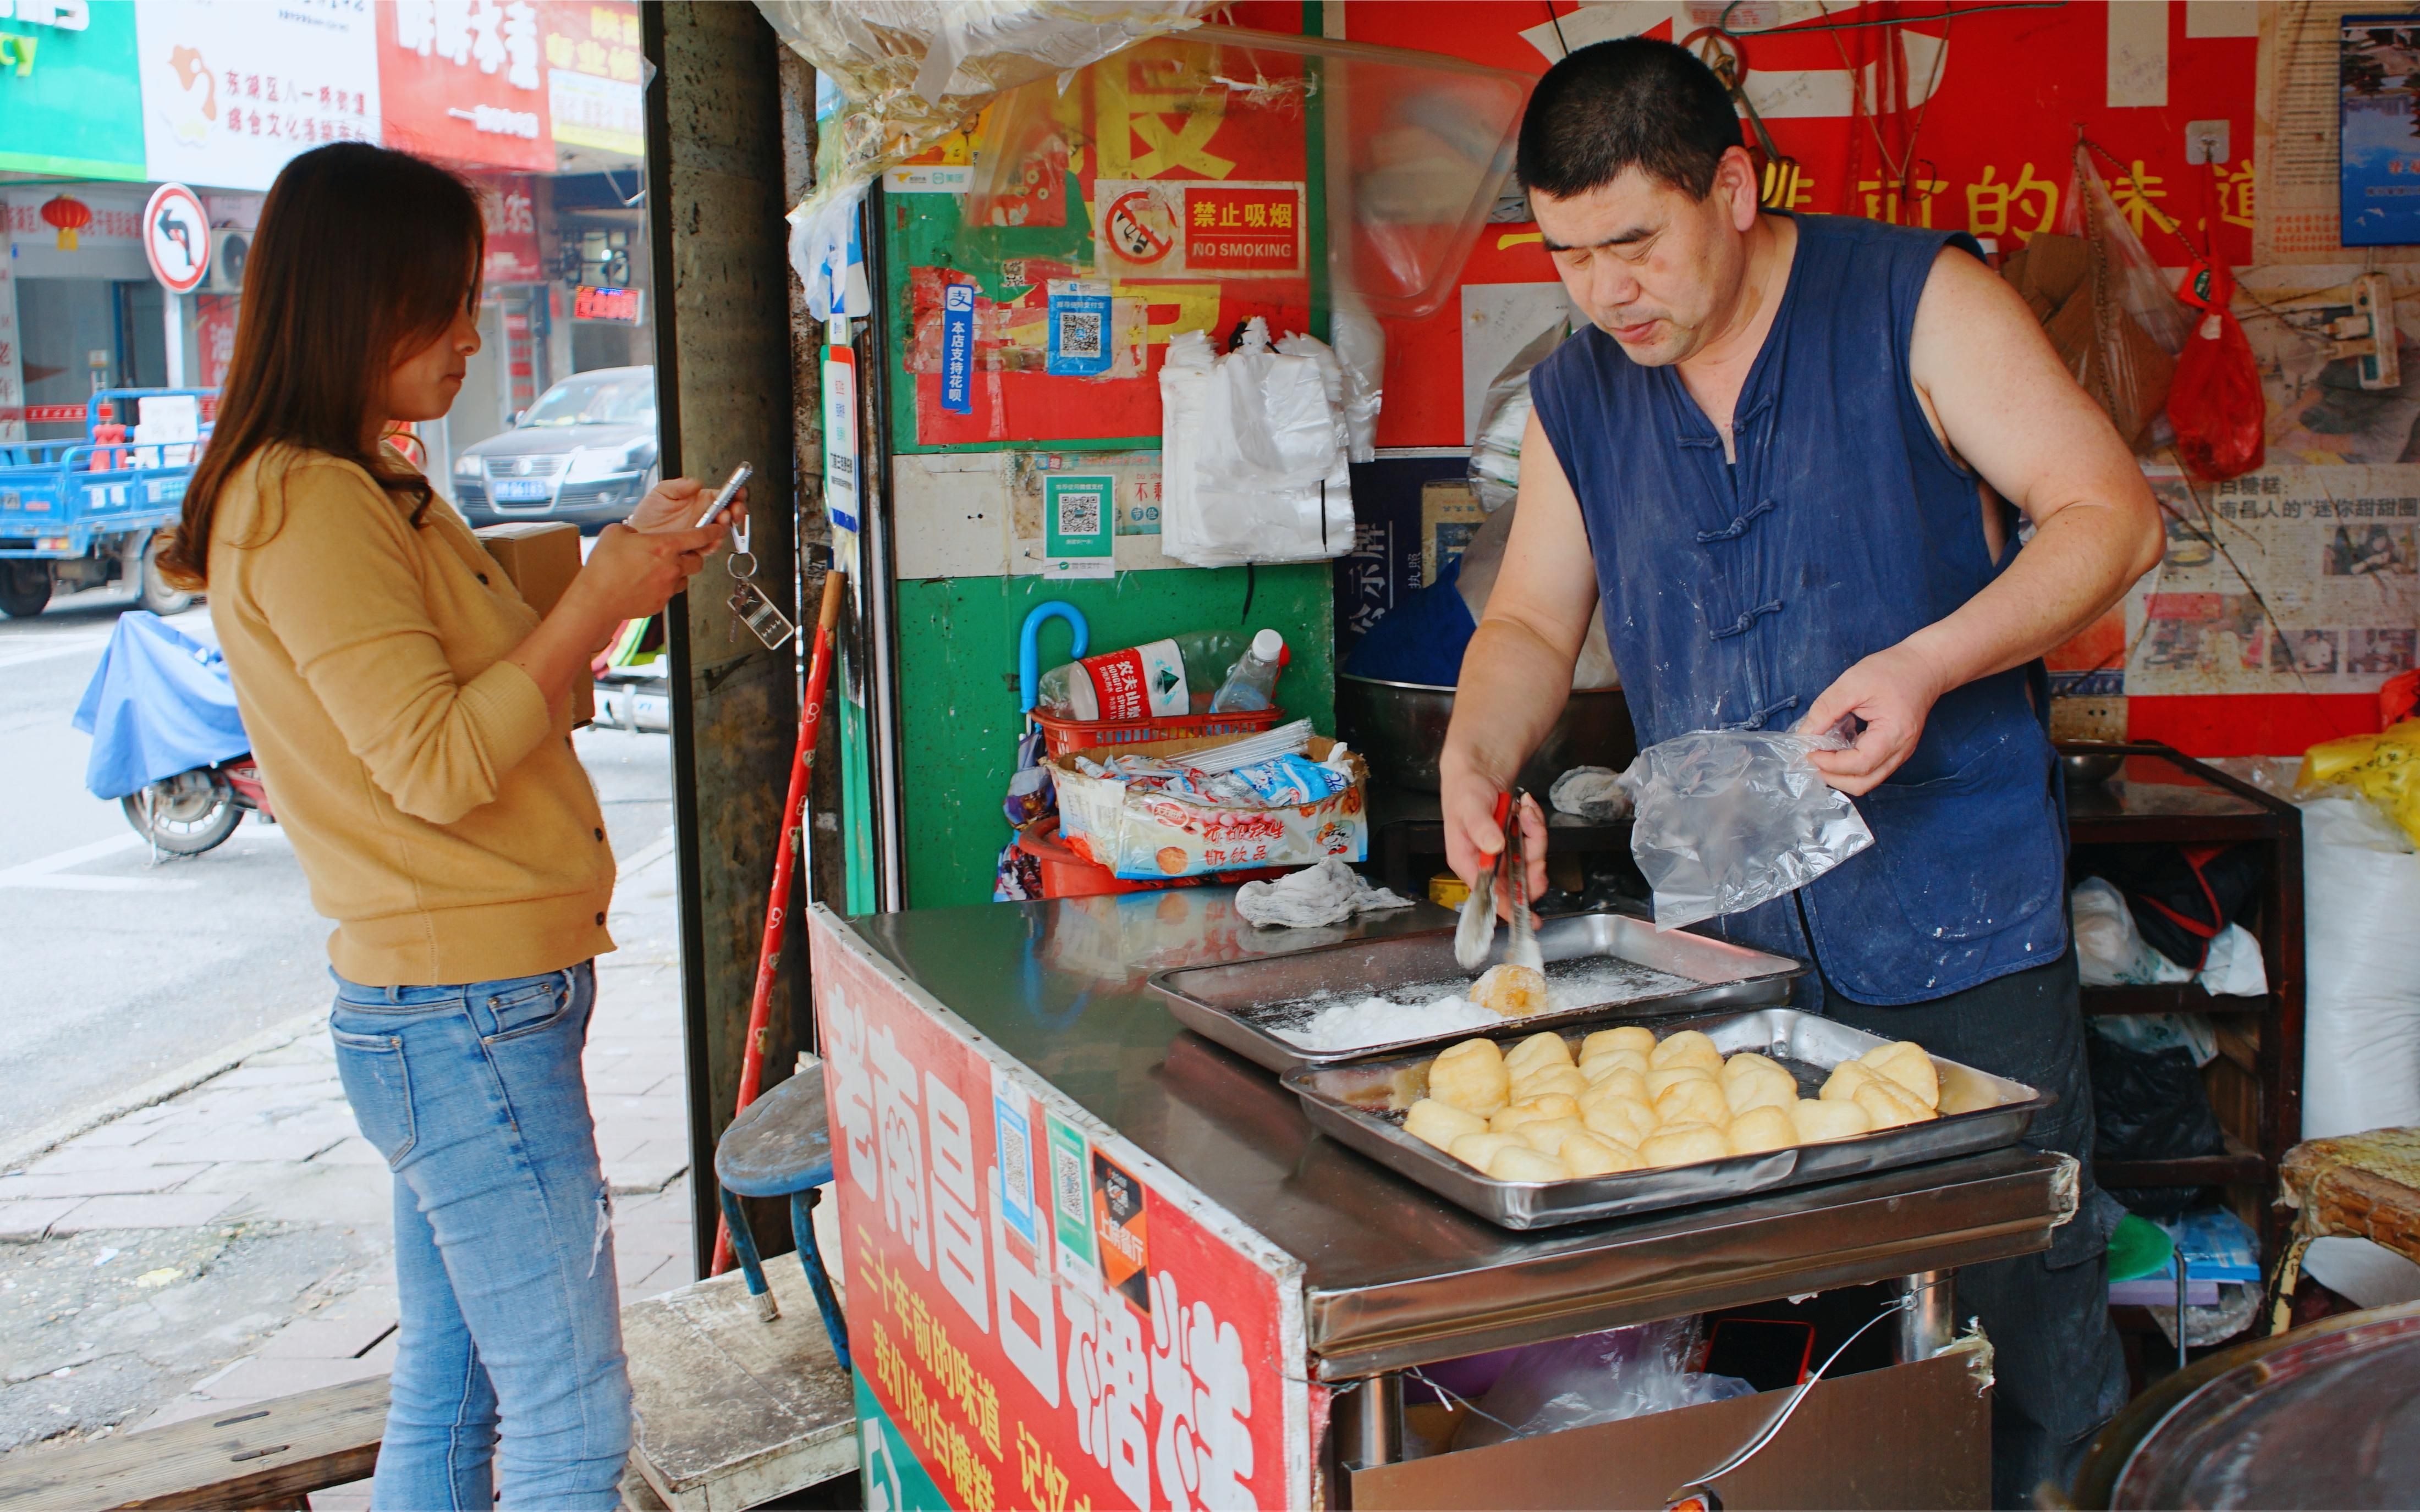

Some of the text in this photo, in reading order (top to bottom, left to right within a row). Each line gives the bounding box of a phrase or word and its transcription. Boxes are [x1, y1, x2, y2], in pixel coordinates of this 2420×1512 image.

[1194, 201, 1292, 228] 禁止吸烟
[1192, 242, 1292, 258] NO SMOKING
[948, 320, 966, 402] 本店支持花呗
[1107, 664, 1123, 693] NONGFU
[1116, 660, 1141, 719] 农夫山泉
[1204, 845, 1267, 866] 奶饮品
[858, 1223, 1004, 1463] 三十年前的味道
[872, 1318, 996, 1511] 我们的白糖糕
